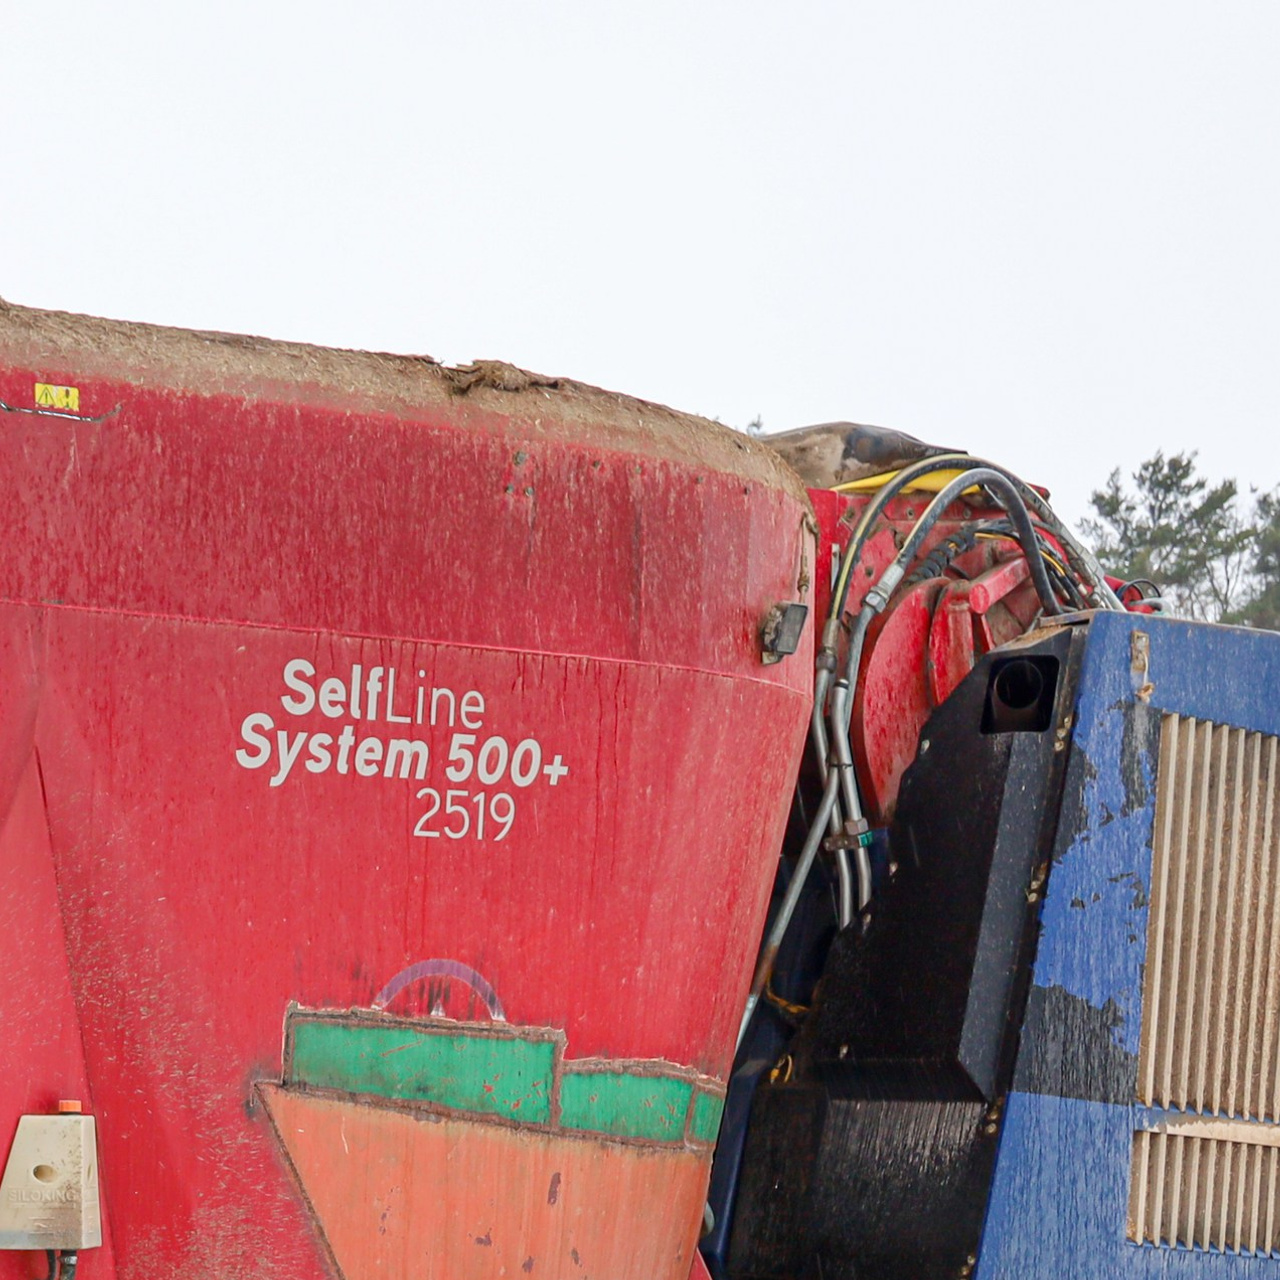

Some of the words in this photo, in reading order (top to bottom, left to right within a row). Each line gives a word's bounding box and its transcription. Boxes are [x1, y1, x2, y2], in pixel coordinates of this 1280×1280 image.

[281, 658, 485, 729] SelfLine
[236, 713, 429, 787] System
[446, 734, 569, 787] 500+
[414, 788, 516, 841] 2519
[8, 1189, 78, 1204] SILOKING
